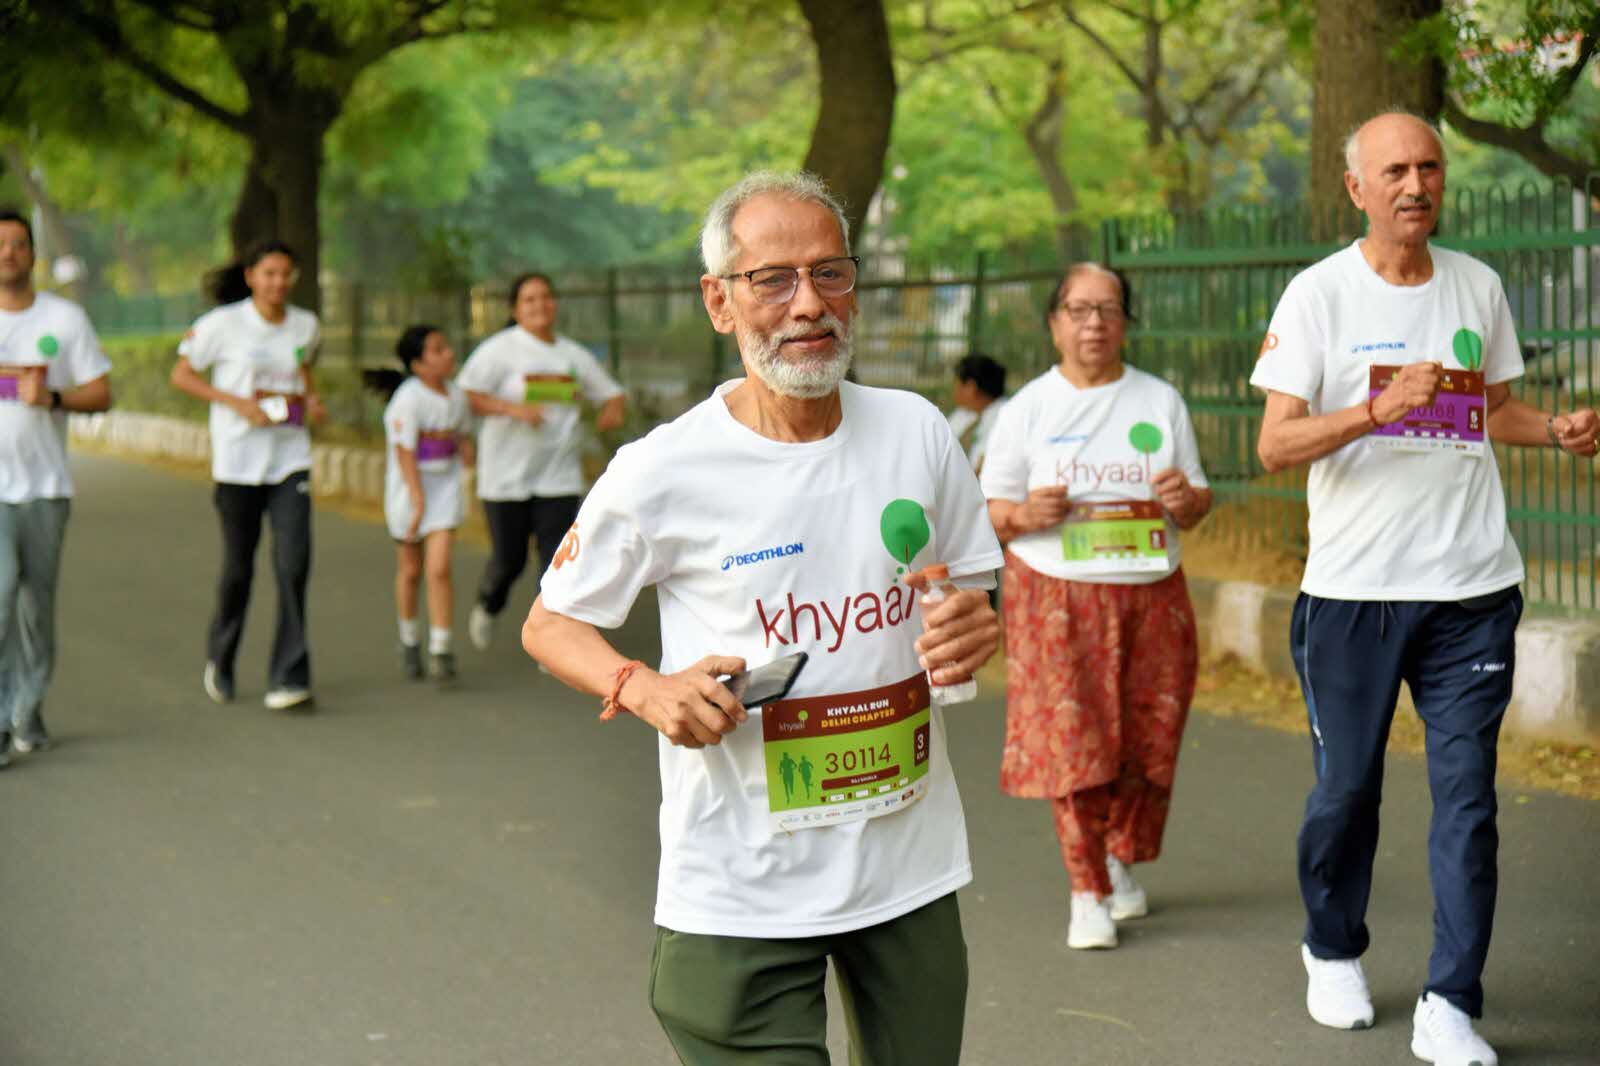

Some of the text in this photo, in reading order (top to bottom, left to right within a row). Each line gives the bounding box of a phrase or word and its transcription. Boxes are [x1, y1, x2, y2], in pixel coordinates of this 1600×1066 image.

[1056, 451, 1151, 491] khyaal
[735, 542, 804, 566] DECATHLON
[821, 707, 896, 729] DELHI CHAPTER
[826, 698, 890, 717] KHYAAL RUN
[917, 733, 924, 750] 3
[825, 743, 892, 774] 30114
